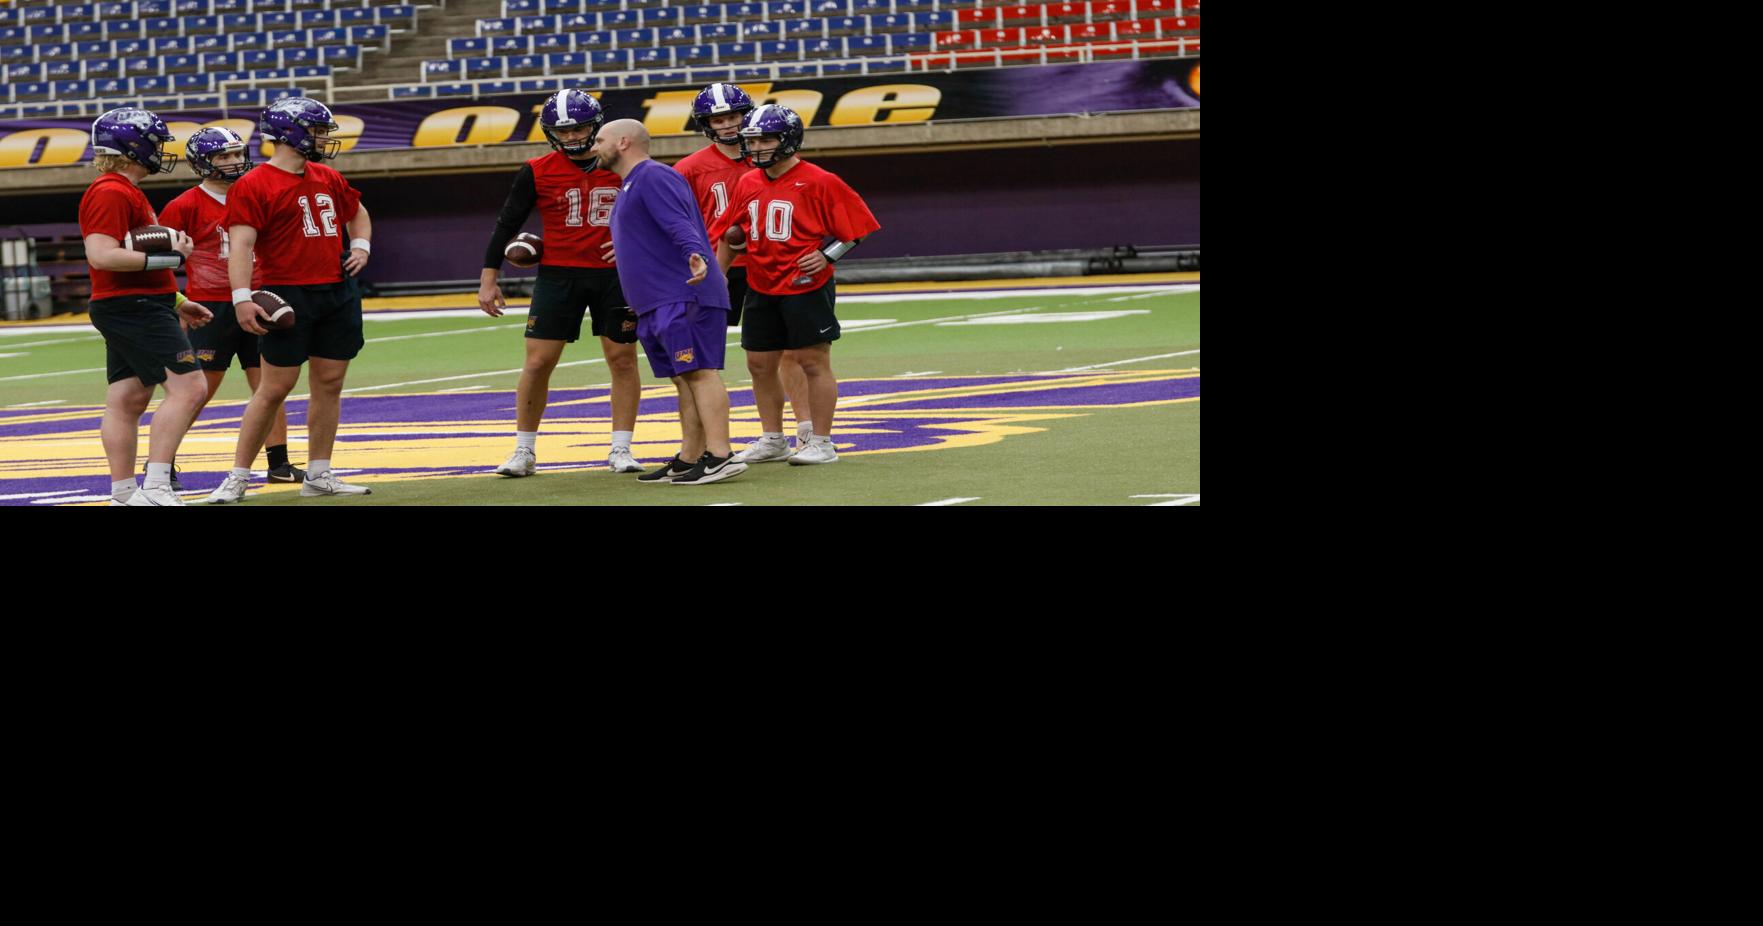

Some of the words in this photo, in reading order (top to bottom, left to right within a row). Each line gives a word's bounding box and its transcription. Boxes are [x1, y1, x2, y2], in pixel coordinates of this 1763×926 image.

[642, 82, 942, 137] the
[298, 193, 339, 238] 12
[565, 186, 621, 227] 16
[747, 199, 794, 241] 10
